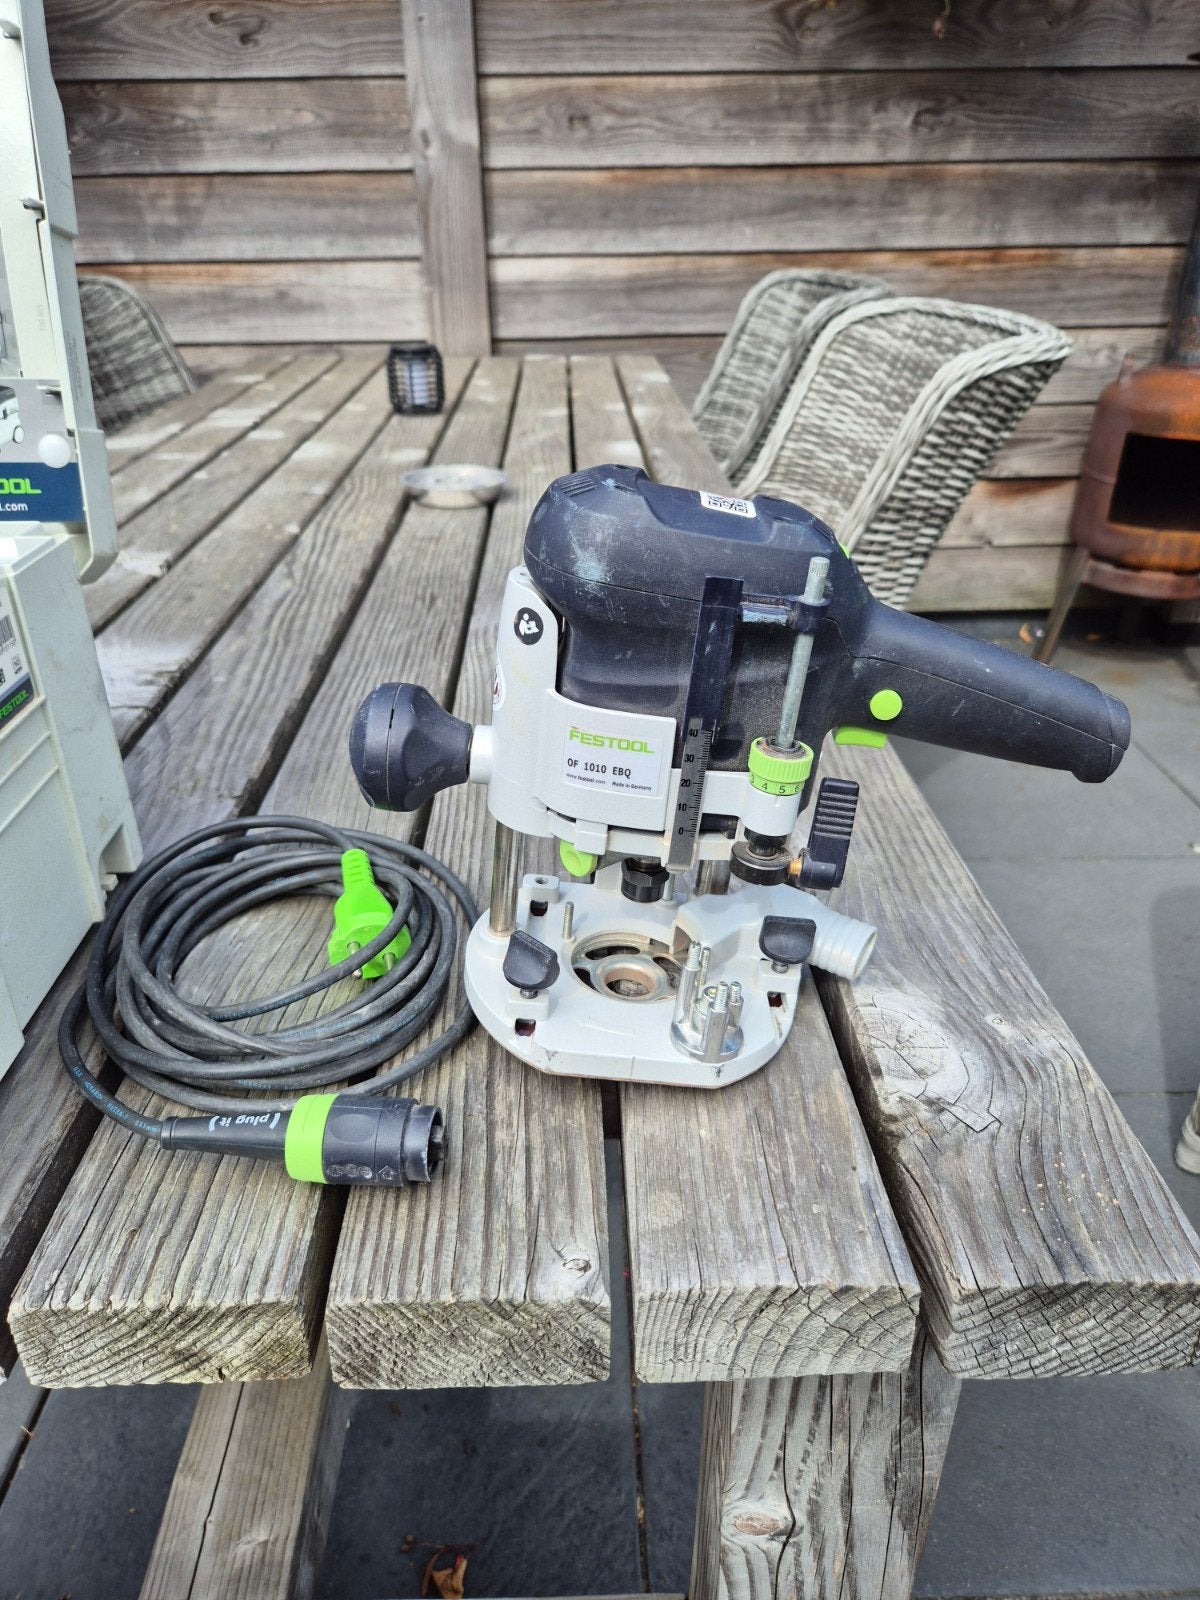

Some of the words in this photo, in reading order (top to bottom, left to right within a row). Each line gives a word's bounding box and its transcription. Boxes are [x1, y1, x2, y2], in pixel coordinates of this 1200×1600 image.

[688, 729, 698, 738] 40
[569, 725, 655, 754] FESTOOL
[684, 754, 694, 763] 30
[567, 757, 579, 768] OF
[584, 761, 607, 774] 1010
[612, 766, 632, 779] EBQ
[680, 779, 691, 788] 20
[762, 782, 768, 790] 4
[778, 785, 786, 794] 5
[794, 784, 800, 793] 6
[677, 803, 687, 812] 10
[678, 827, 684, 835] 0
